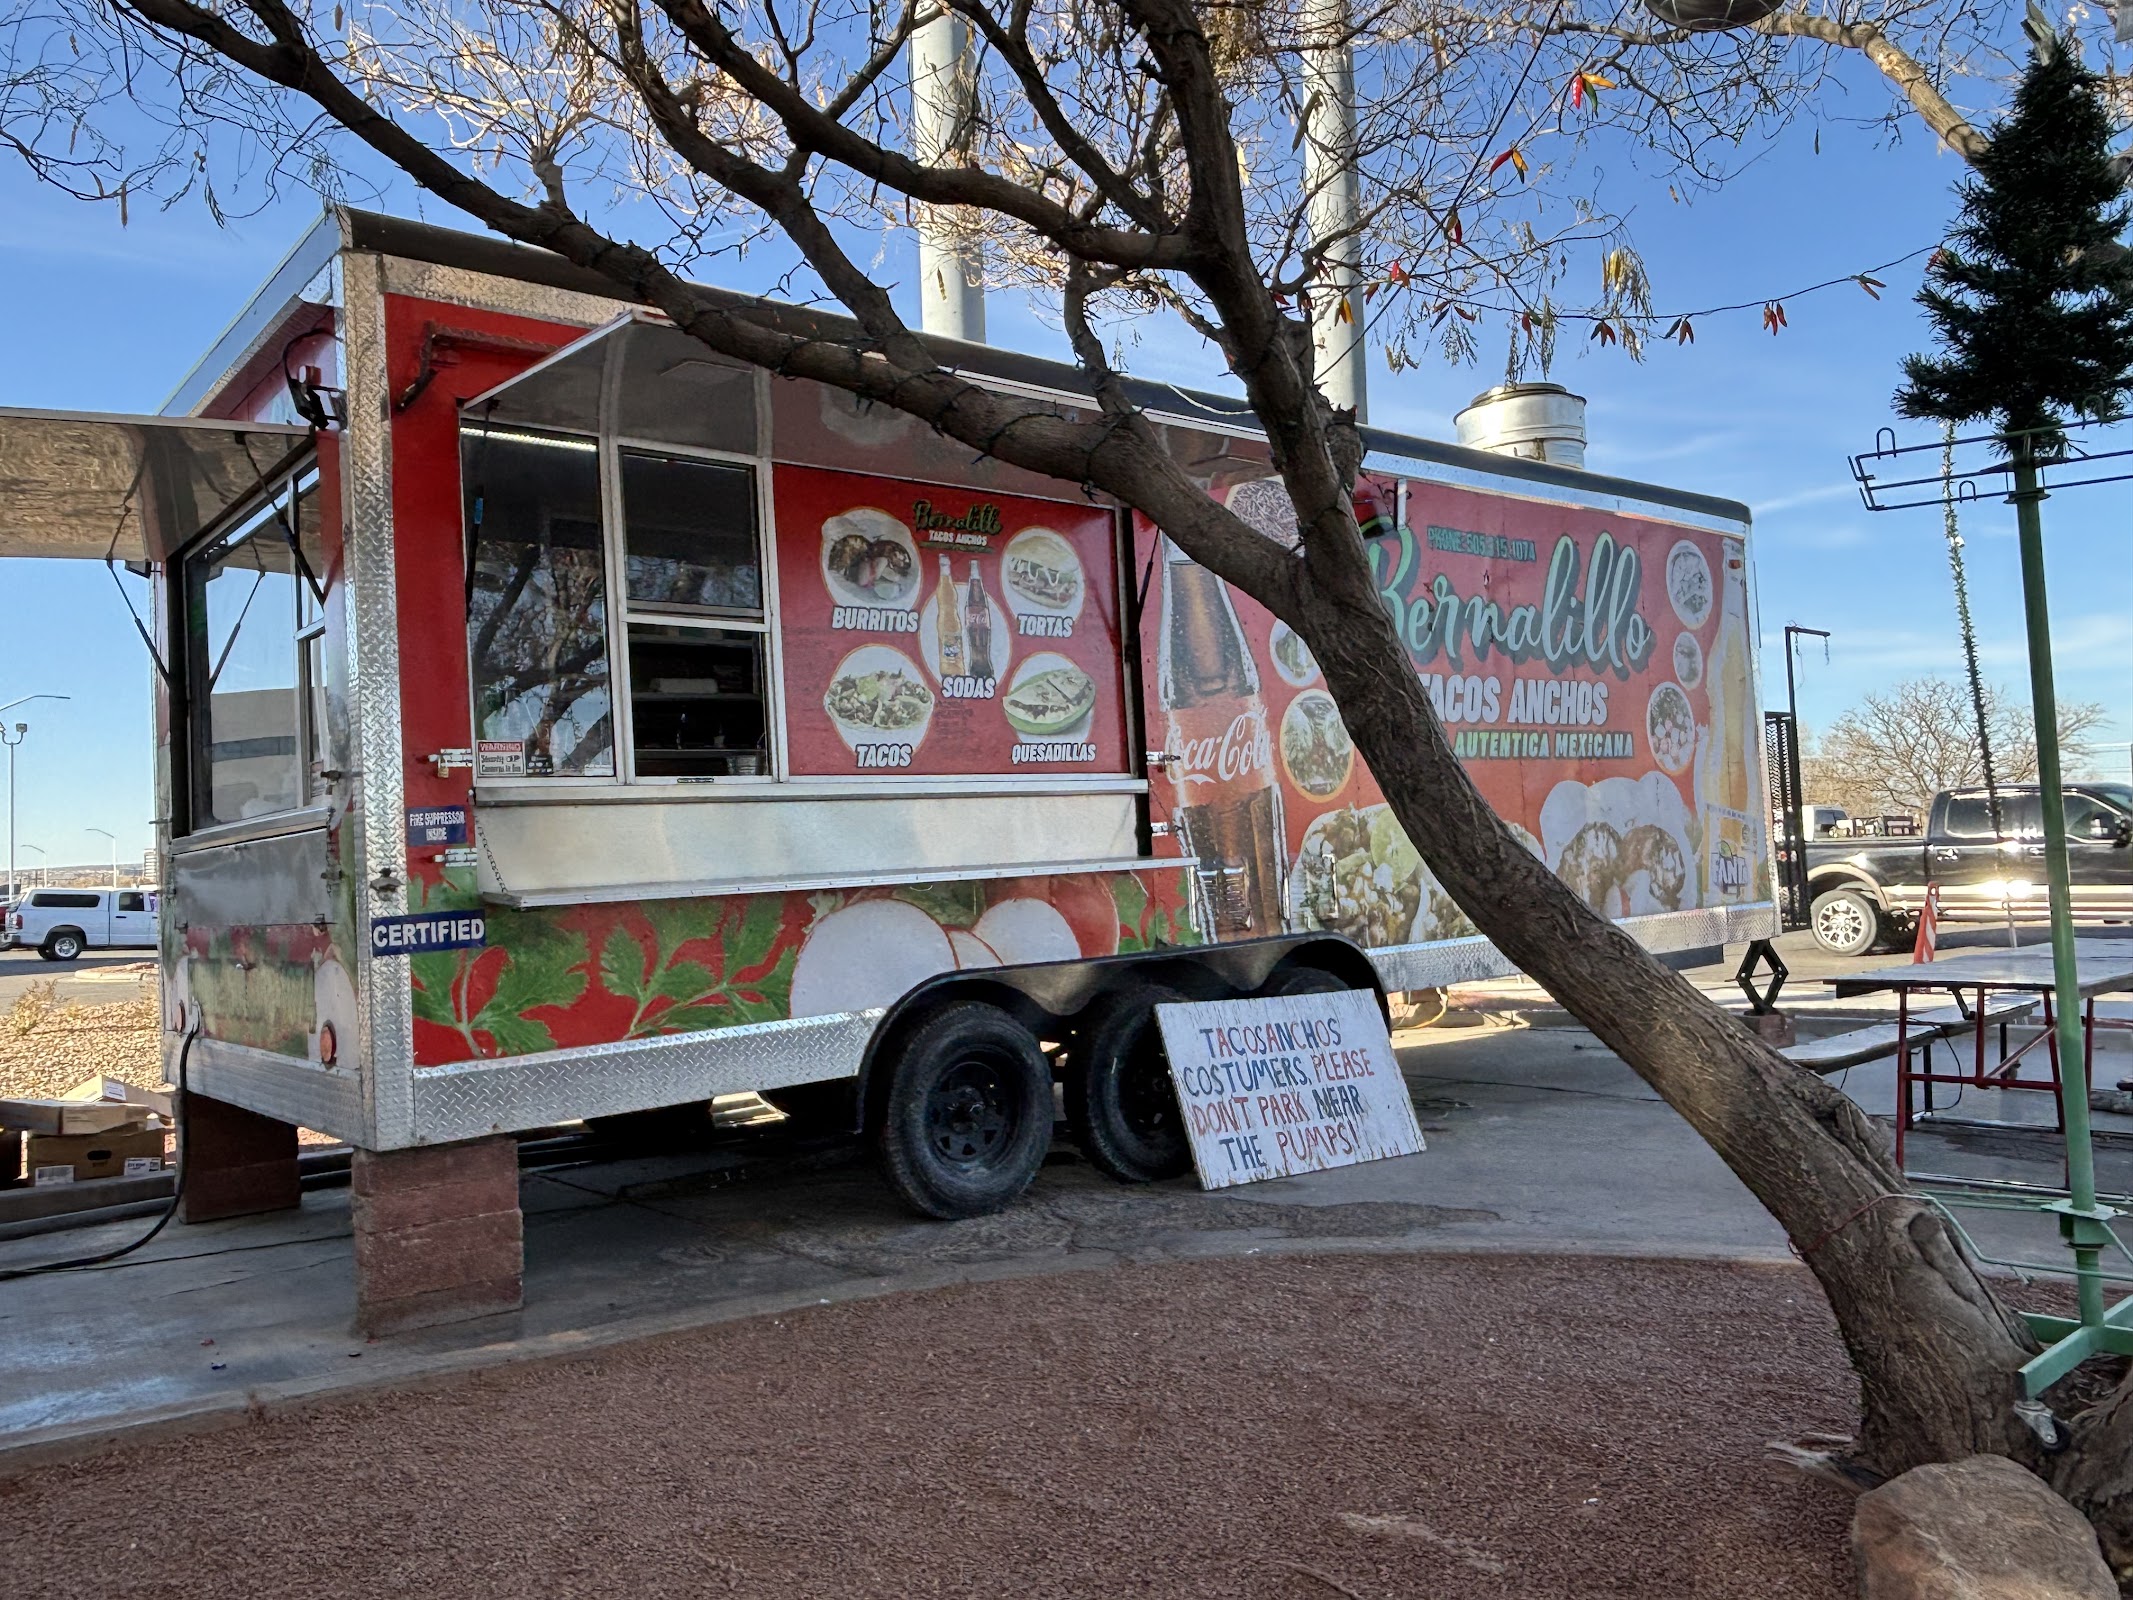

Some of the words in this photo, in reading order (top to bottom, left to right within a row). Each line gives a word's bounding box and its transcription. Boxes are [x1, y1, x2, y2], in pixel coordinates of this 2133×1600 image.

[1367, 526, 1654, 676] Bernalillo
[832, 606, 919, 633] BURRITOS
[1018, 613, 1073, 638] TORTAS
[942, 676, 996, 699] SODAS
[1506, 678, 1609, 726] ANCHOS
[855, 744, 912, 767] TACOS
[1011, 743, 1097, 764] QUESADILLAS
[1453, 731, 1550, 758] AUTENTICA
[372, 918, 485, 949] CERTIFIED
[1200, 1018, 1342, 1059] TACOSANCHOS
[1310, 1048, 1375, 1084] PLEASE
[1257, 1091, 1311, 1128] PARK
[1311, 1084, 1366, 1121] NEAR
[1218, 1134, 1267, 1172] THE
[1275, 1120, 1361, 1164] PUMPS!
